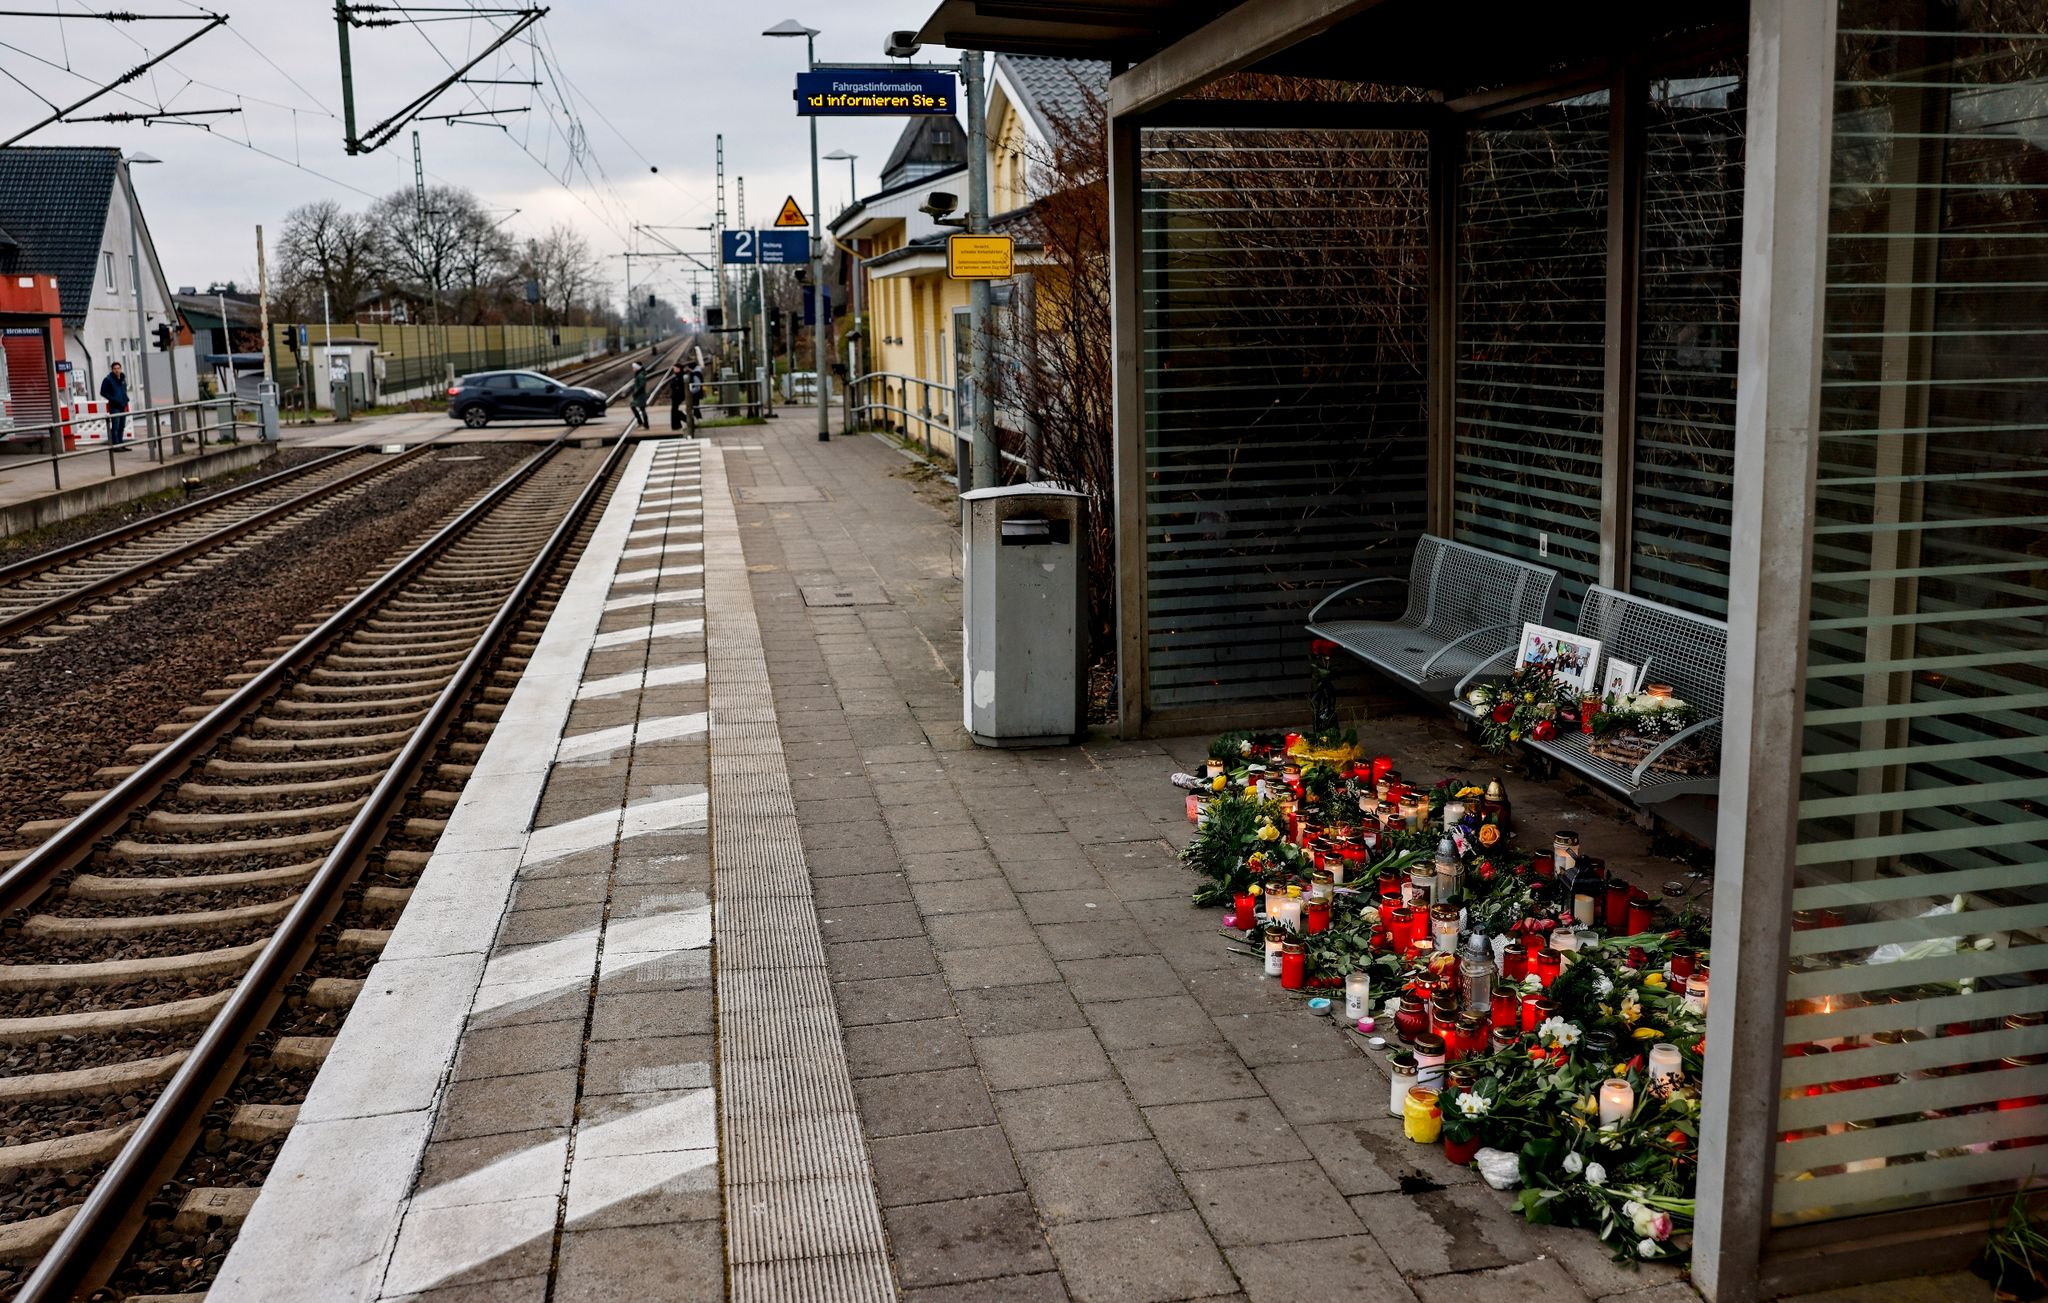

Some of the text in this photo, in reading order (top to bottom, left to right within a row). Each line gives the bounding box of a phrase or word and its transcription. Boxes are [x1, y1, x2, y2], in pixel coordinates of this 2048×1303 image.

[832, 82, 922, 93] Fahrgastinformation
[827, 94, 909, 106] informieren
[912, 94, 935, 106] Sie
[735, 231, 752, 257] 2
